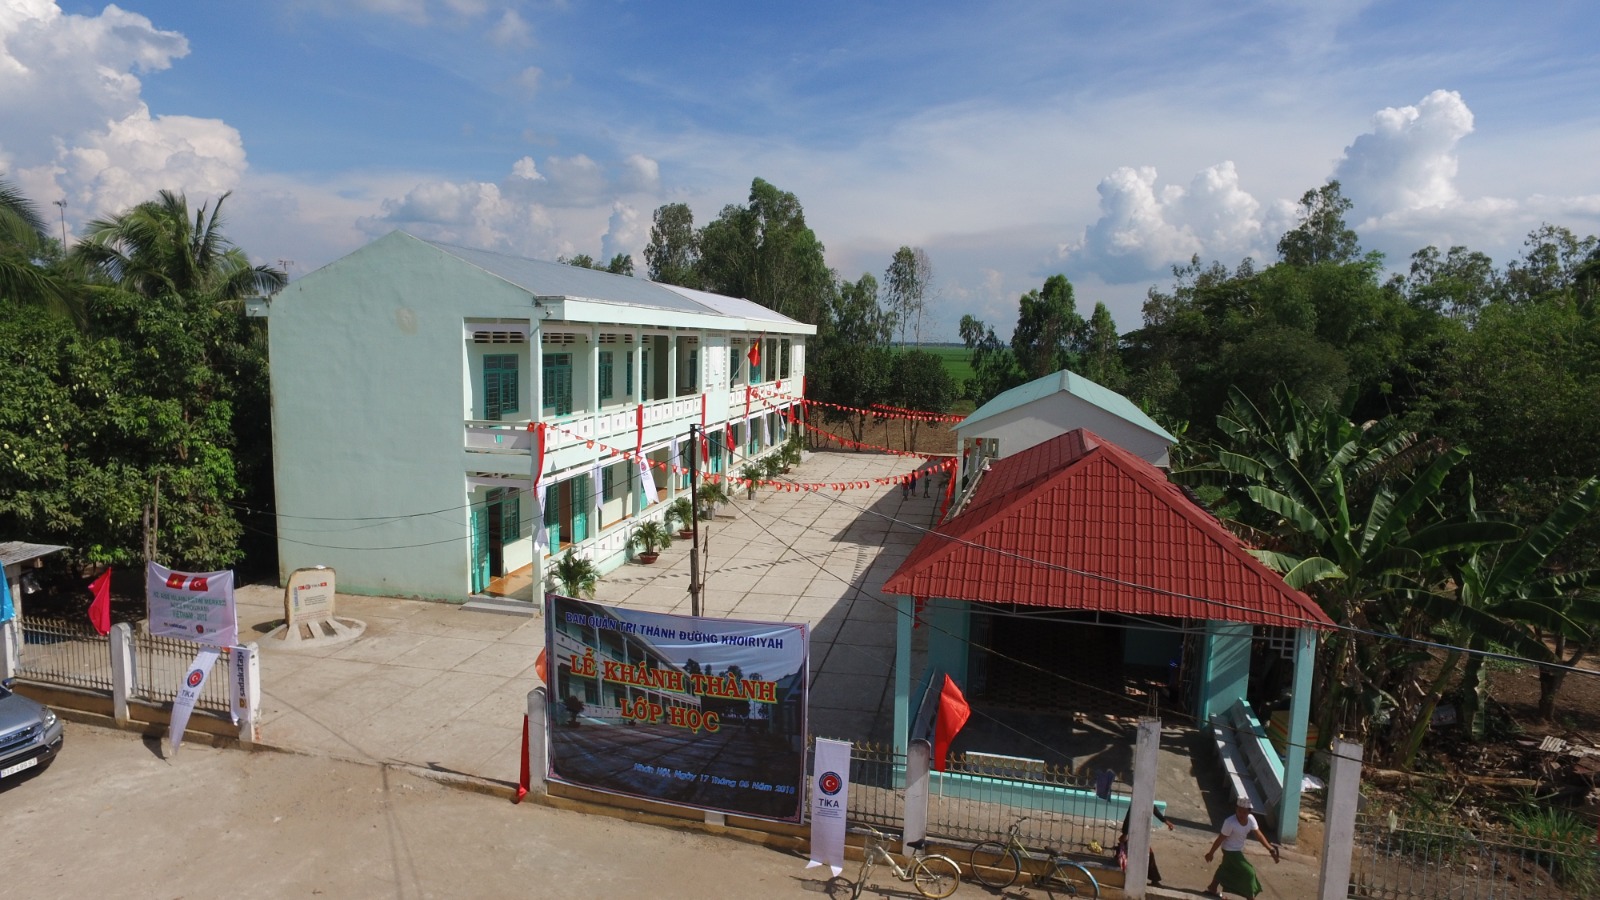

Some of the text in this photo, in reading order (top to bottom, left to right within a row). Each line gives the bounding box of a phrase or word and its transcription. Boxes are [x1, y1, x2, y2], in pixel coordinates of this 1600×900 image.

[565, 611, 783, 649] BAN QUẢN TRỊ THÁNH ĐƯỜNG KHOIRIYAH
[570, 647, 778, 704] LỄ KHÁNH THÀNH
[620, 696, 720, 734] LỚP HỌC
[699, 774, 710, 783] 17
